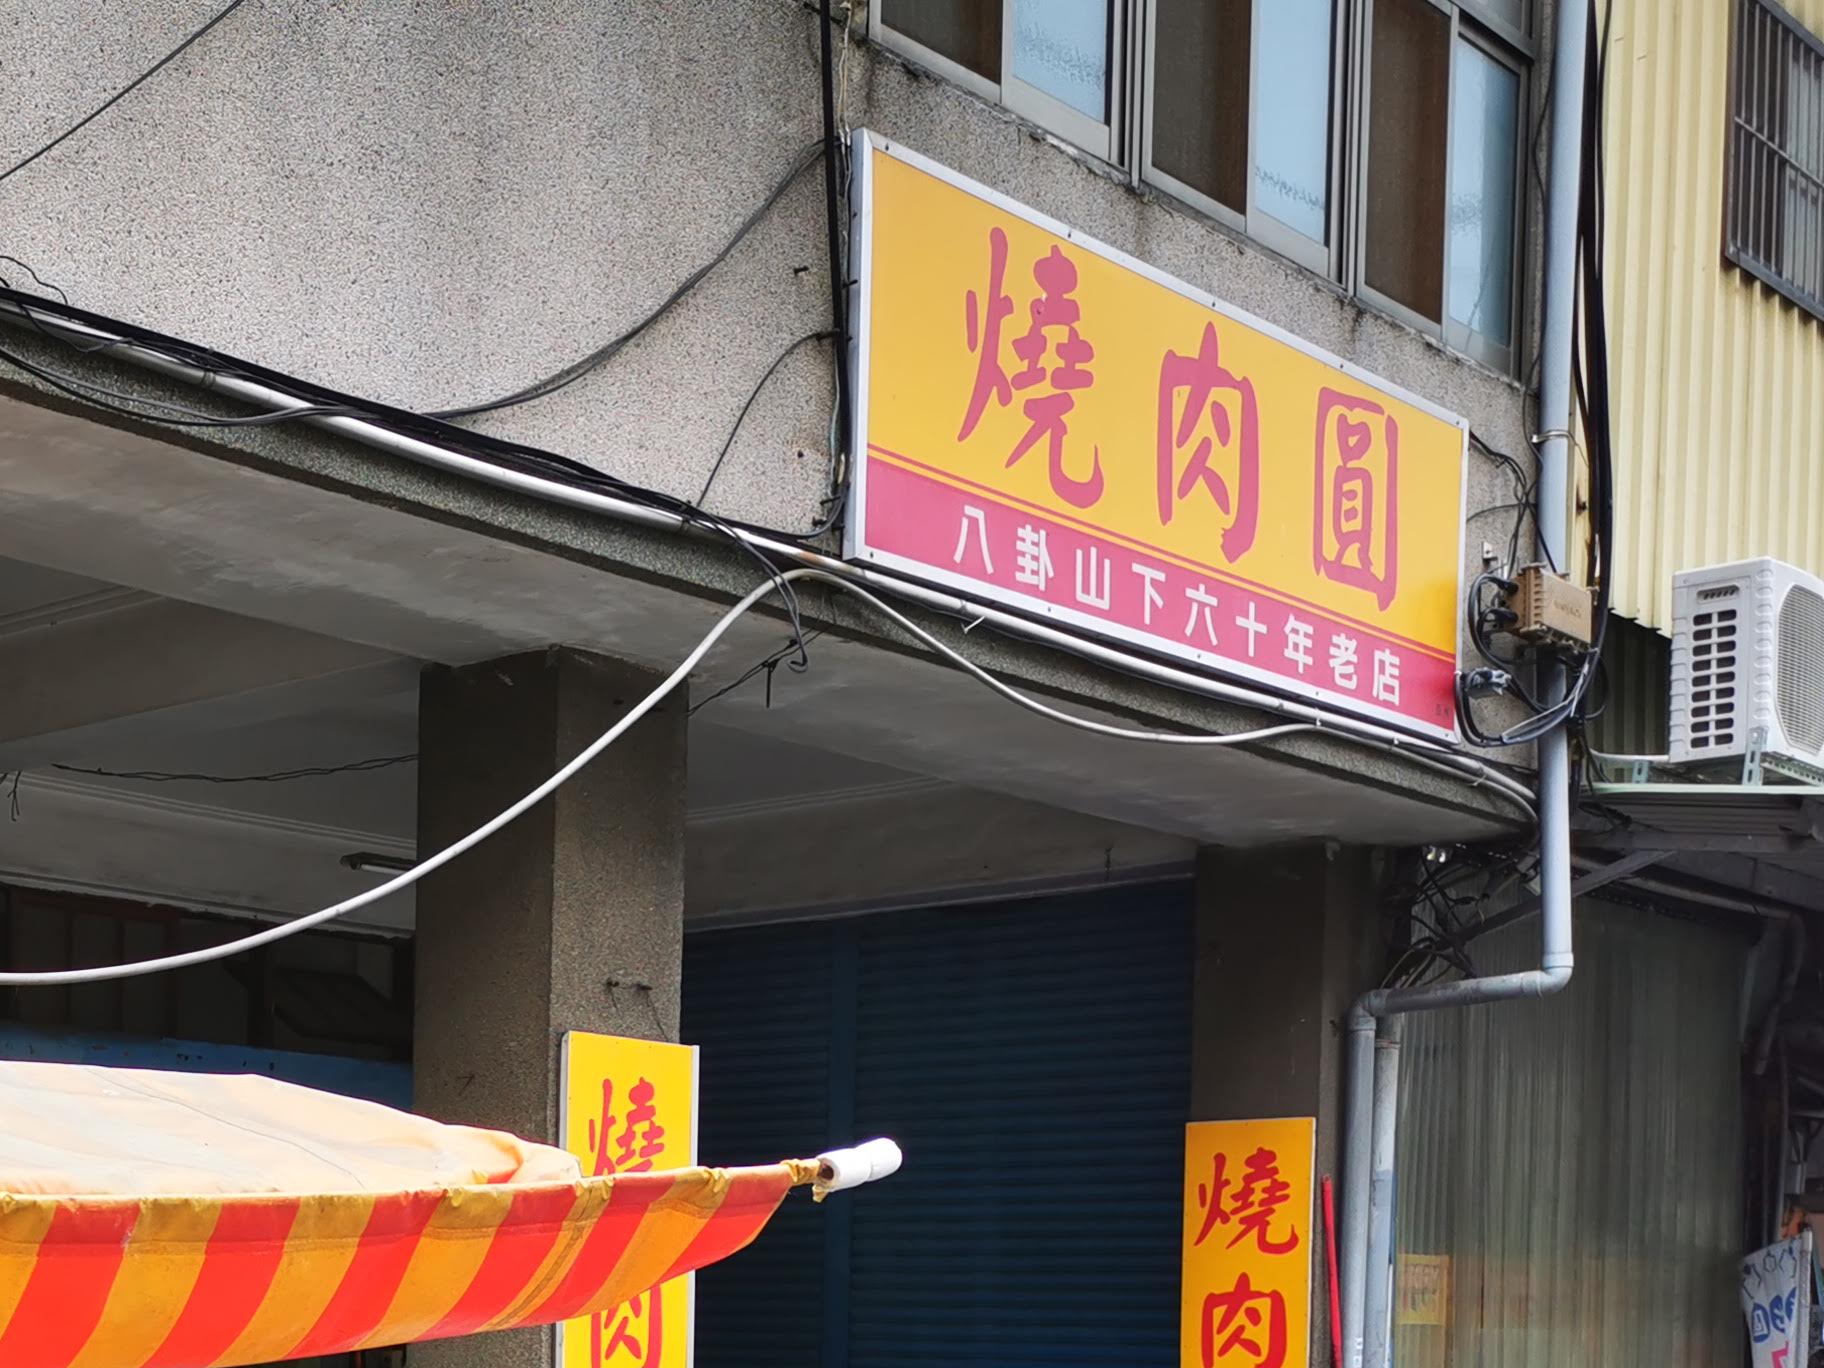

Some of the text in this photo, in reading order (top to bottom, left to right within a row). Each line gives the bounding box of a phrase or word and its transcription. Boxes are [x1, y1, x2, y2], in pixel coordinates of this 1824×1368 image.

[958, 226, 1398, 612] 燒肉圓
[953, 504, 1401, 706] 八卦山下六十年老店
